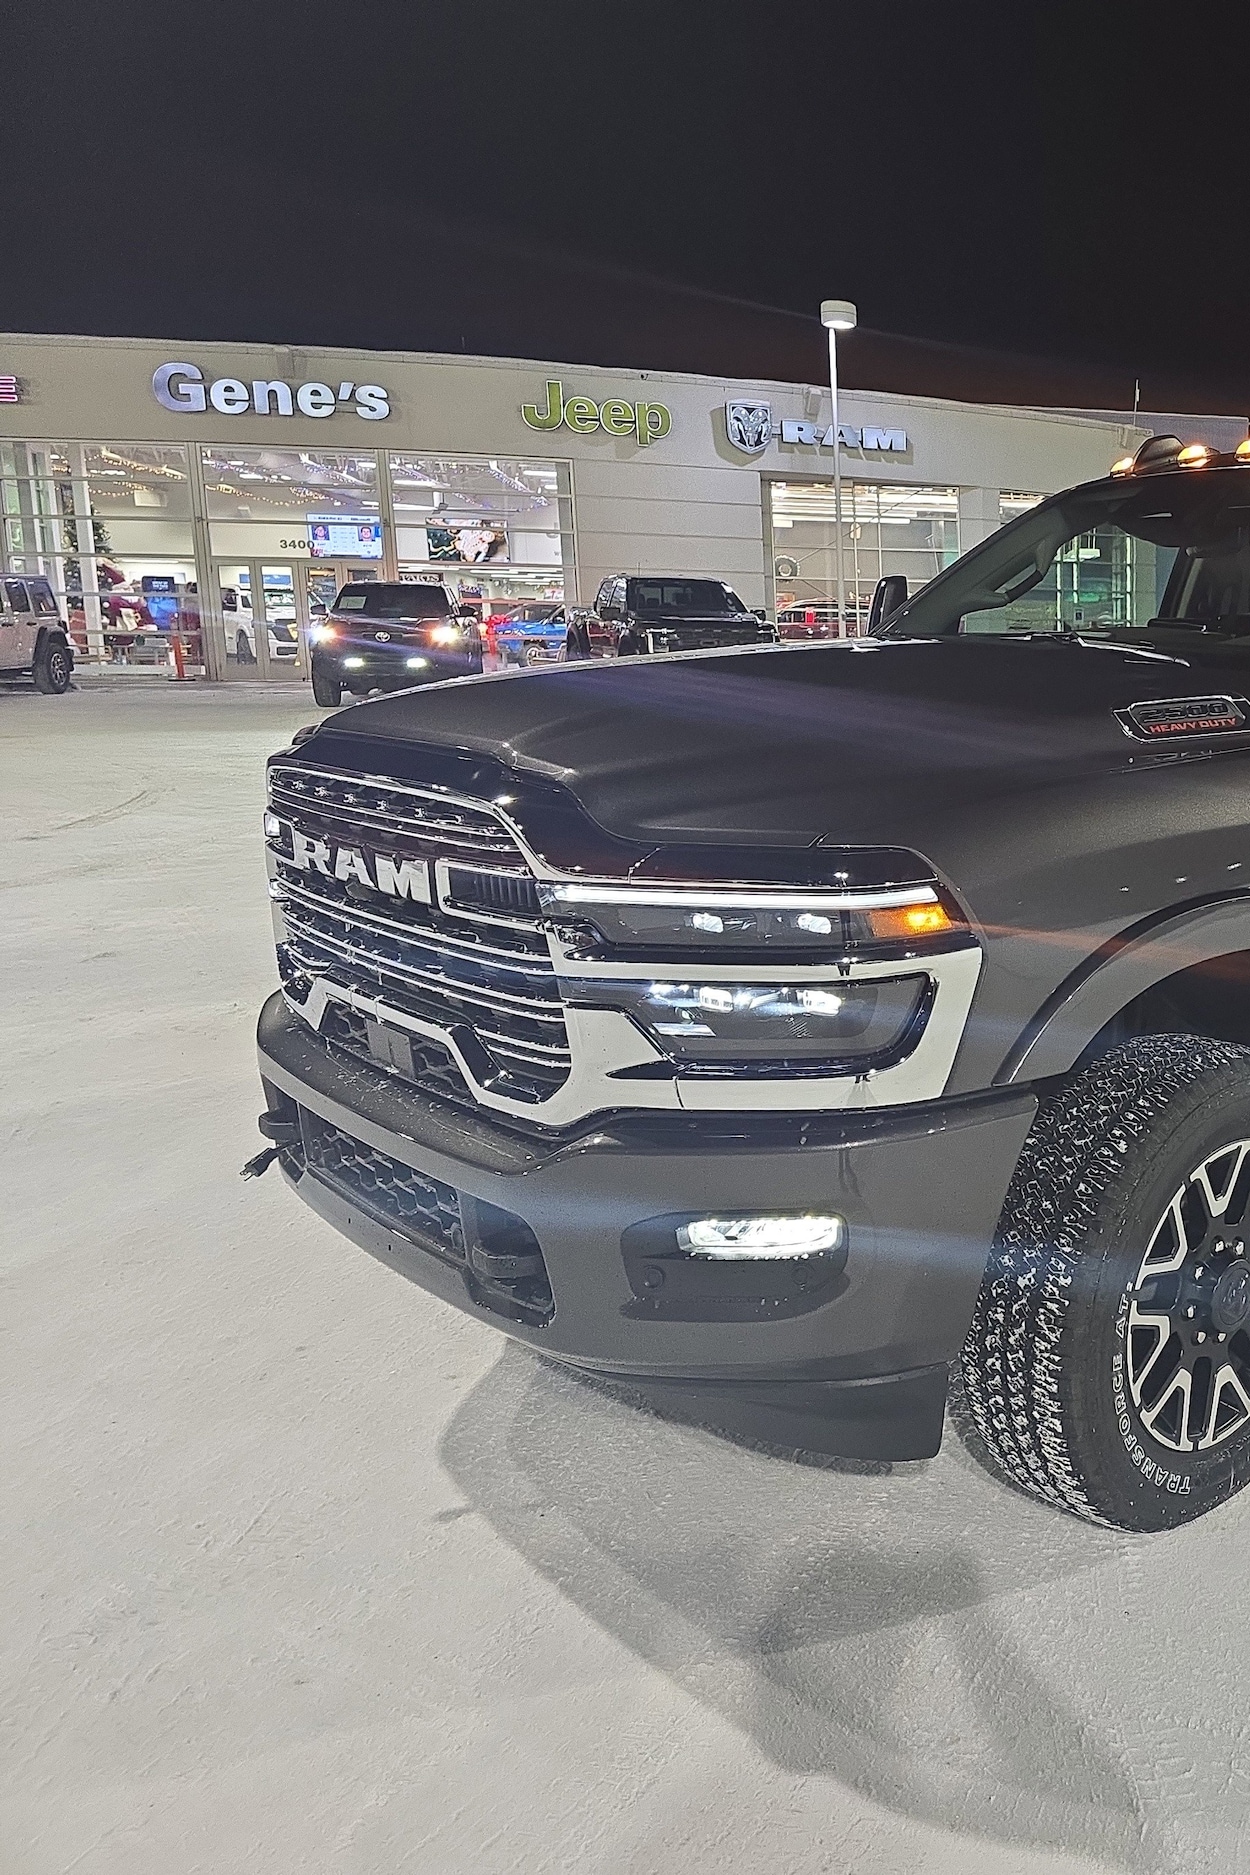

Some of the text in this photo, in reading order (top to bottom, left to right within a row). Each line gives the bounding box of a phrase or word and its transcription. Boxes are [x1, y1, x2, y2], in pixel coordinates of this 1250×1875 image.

[152, 361, 391, 421] Gene's
[521, 379, 673, 448] Jeep
[780, 419, 908, 452] RAM
[279, 539, 315, 549] 3400
[1140, 702, 1229, 722] 2500
[1149, 717, 1237, 733] HEAVY DUTY
[294, 830, 432, 905] RAM
[1112, 1352, 1192, 1495] TRANSFORCE
